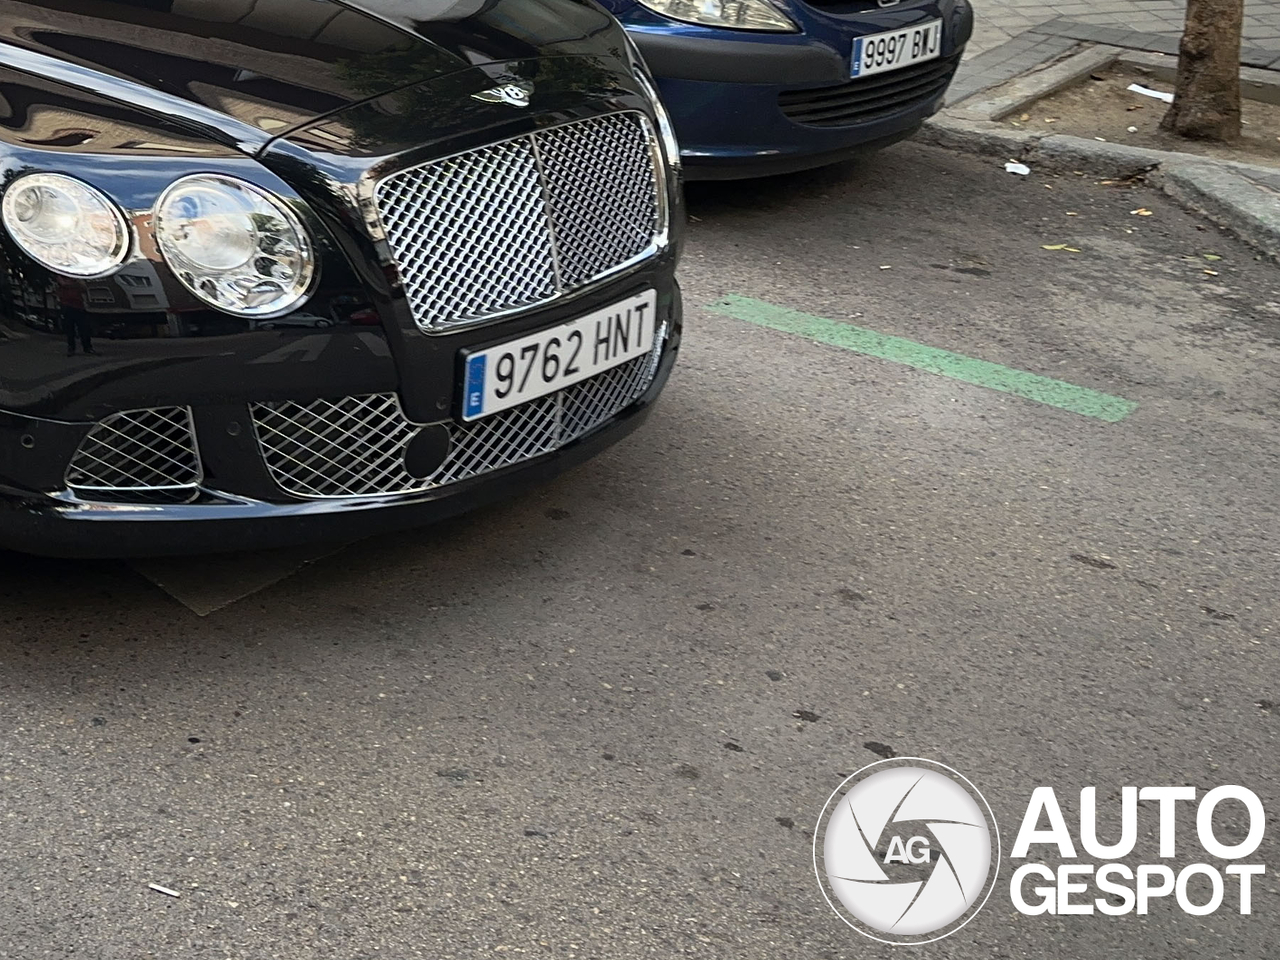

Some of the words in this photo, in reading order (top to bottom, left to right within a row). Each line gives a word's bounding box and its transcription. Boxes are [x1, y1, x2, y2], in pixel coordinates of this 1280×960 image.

[864, 33, 907, 69] 9997
[470, 392, 480, 406] E
[494, 330, 583, 399] 9762
[593, 302, 650, 365] HNT
